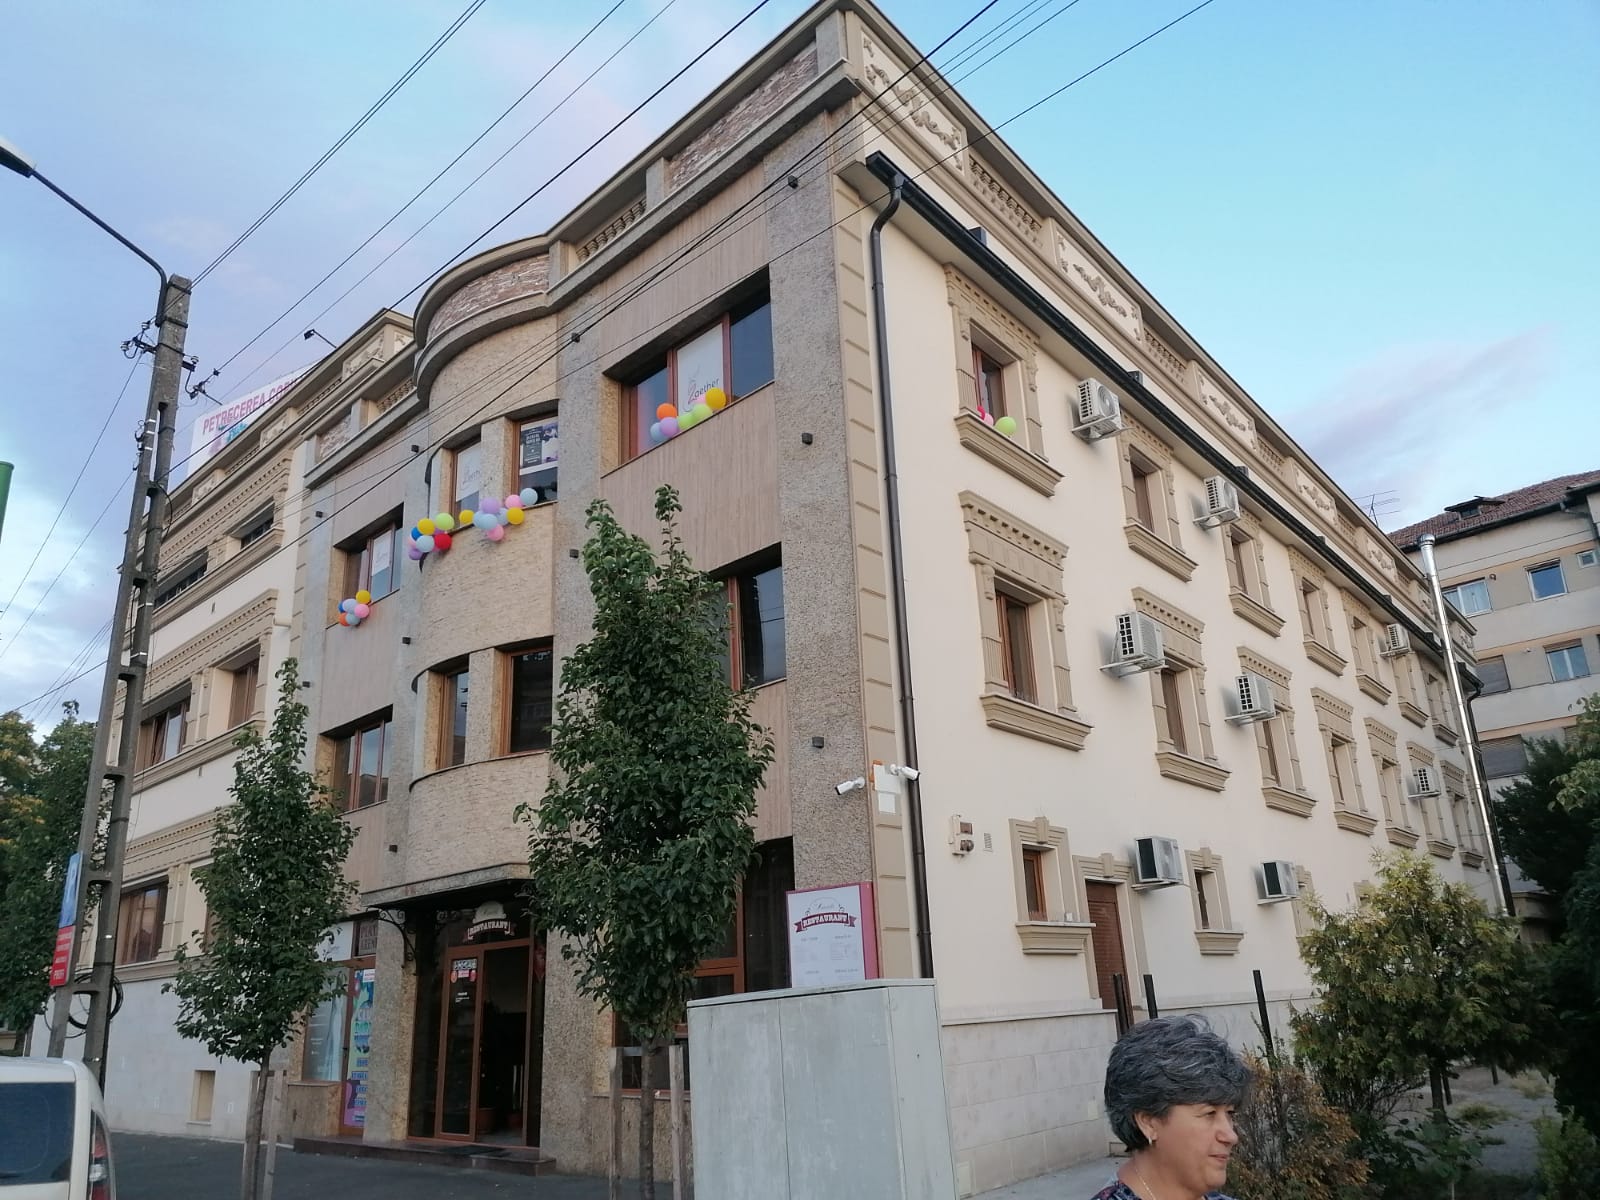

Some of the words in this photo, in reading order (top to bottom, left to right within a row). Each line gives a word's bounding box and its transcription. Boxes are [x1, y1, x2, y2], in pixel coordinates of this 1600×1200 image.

[202, 391, 266, 436] PETRECEREA
[469, 920, 509, 935] RESTAURANT
[802, 913, 849, 928] RESTAURANT
